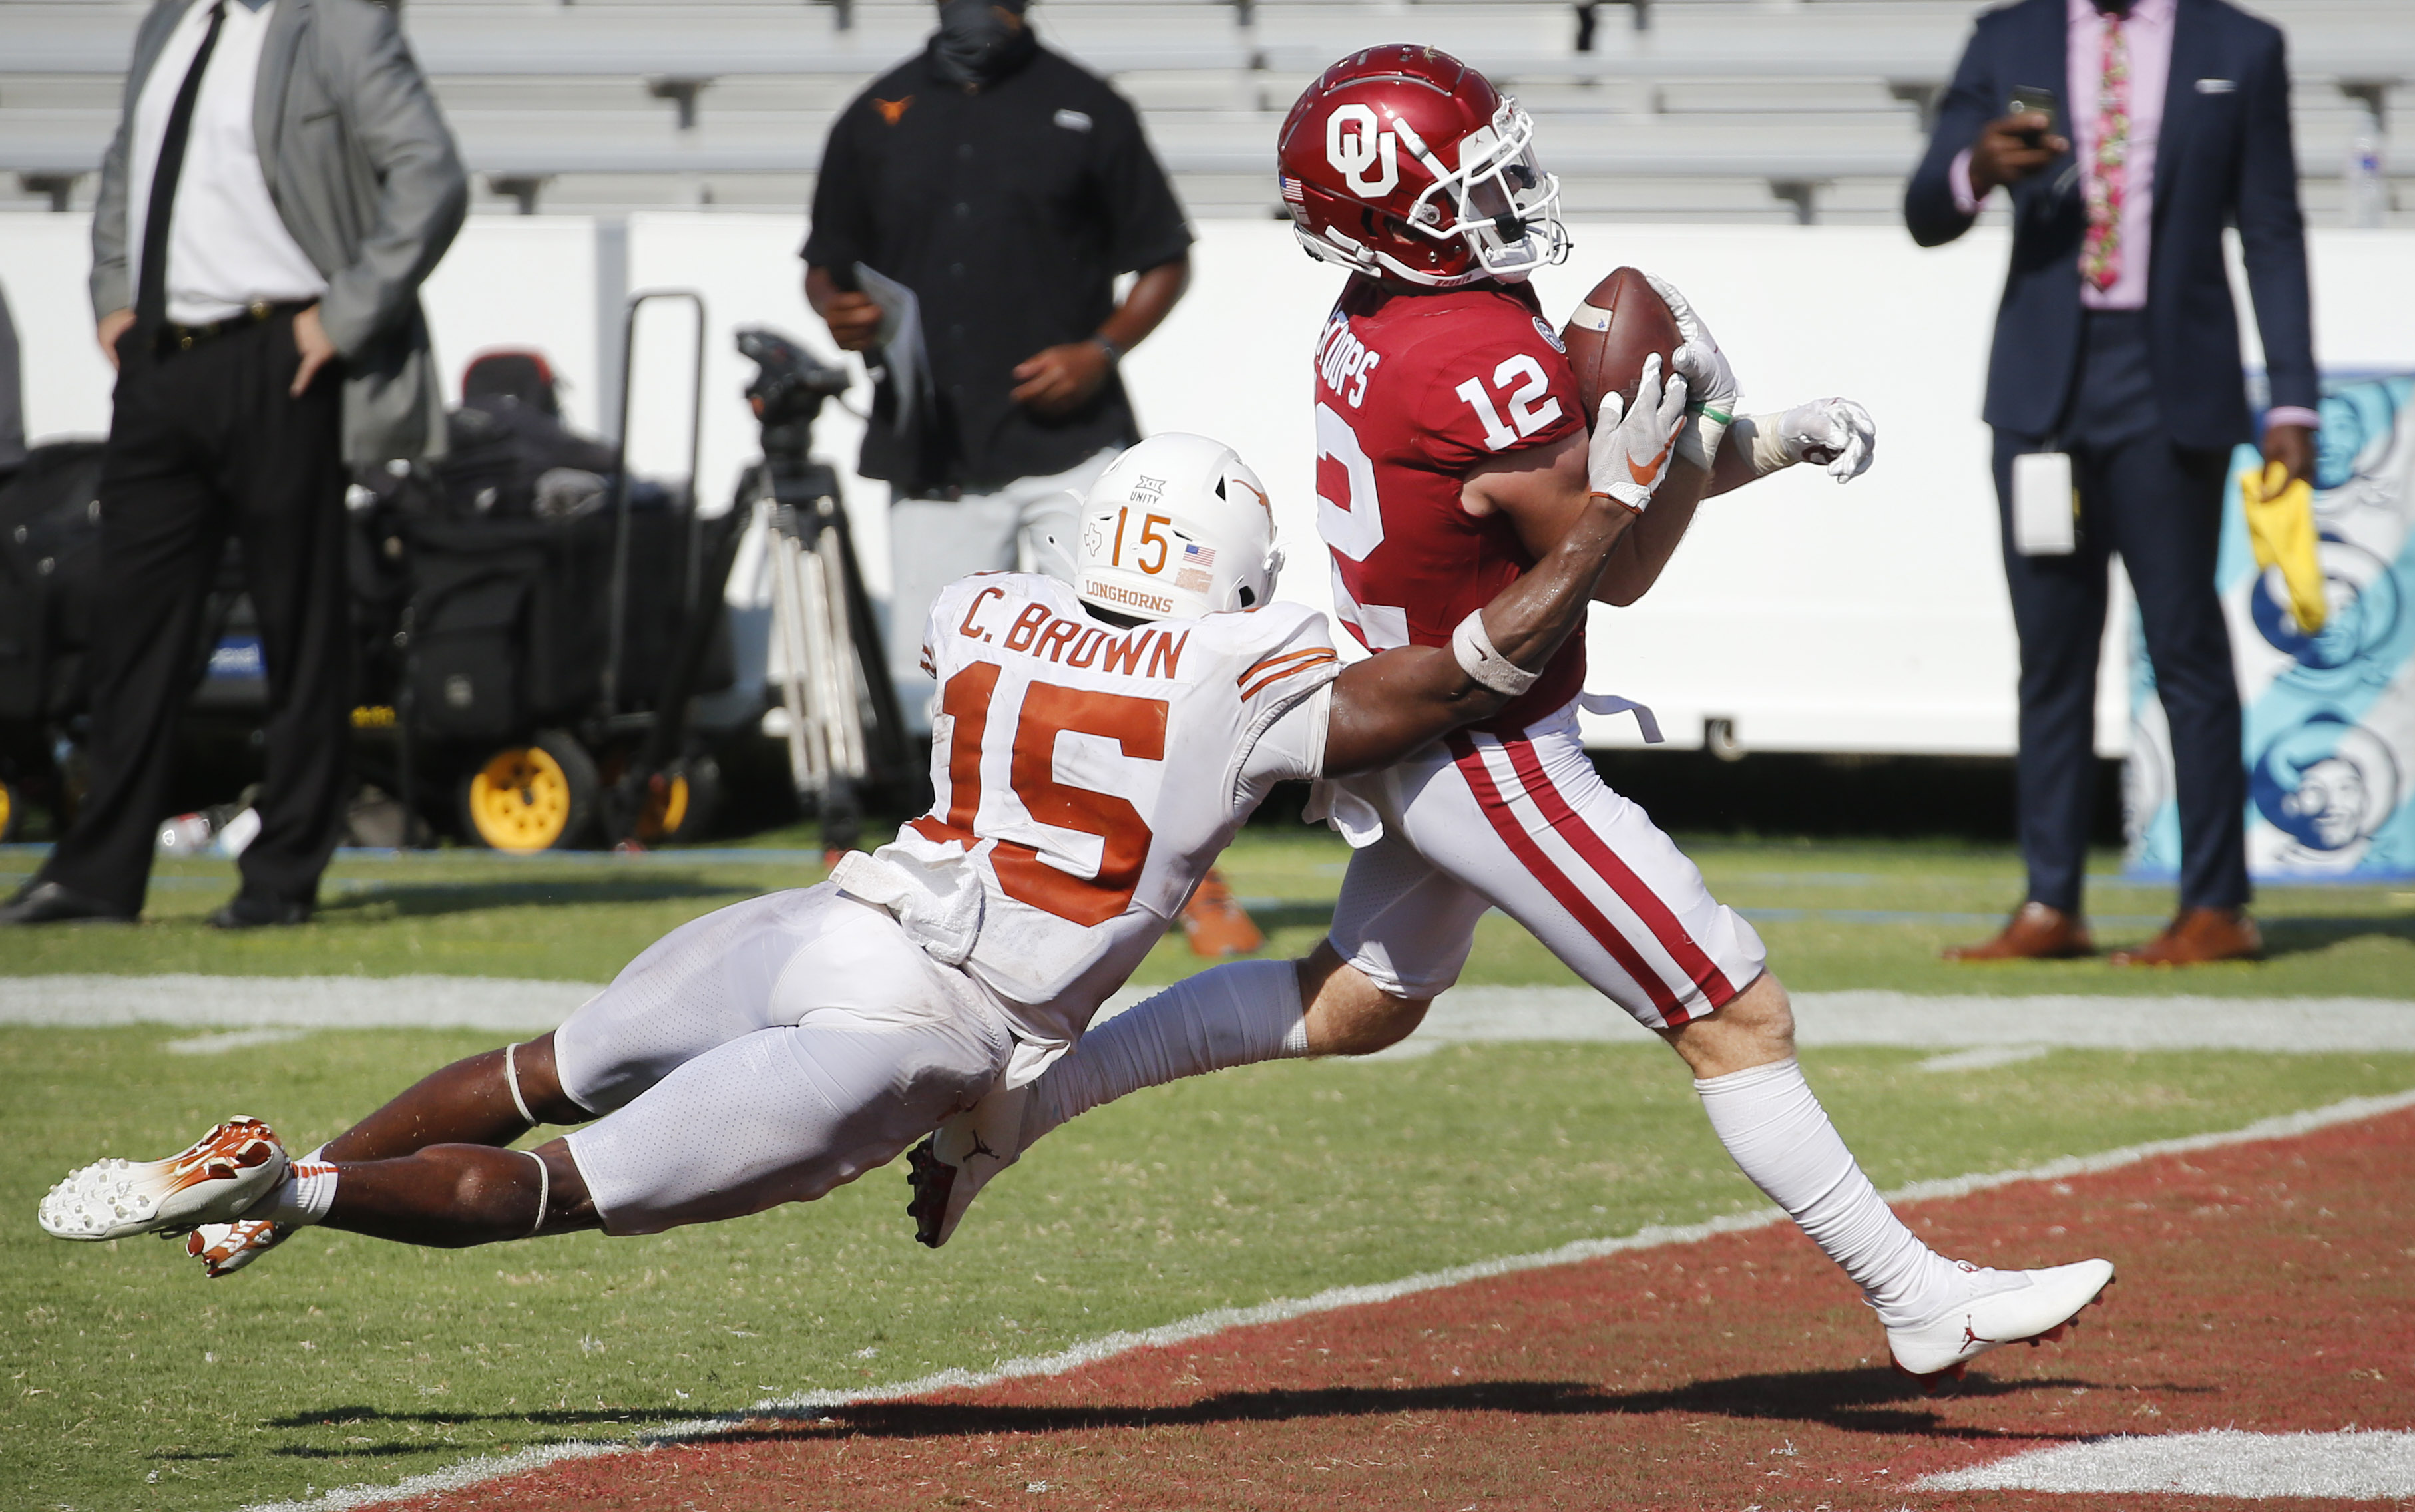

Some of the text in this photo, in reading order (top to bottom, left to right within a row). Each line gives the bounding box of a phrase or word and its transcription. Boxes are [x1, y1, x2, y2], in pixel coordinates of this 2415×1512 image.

[1327, 104, 1399, 198] OU
[1454, 353, 1563, 451] 12
[1112, 506, 1171, 574] 15
[1130, 491, 1159, 504] UNITY
[960, 587, 1191, 679] C. BROWN
[1086, 580, 1174, 612] LONGHORNS
[906, 660, 1169, 928] 15
